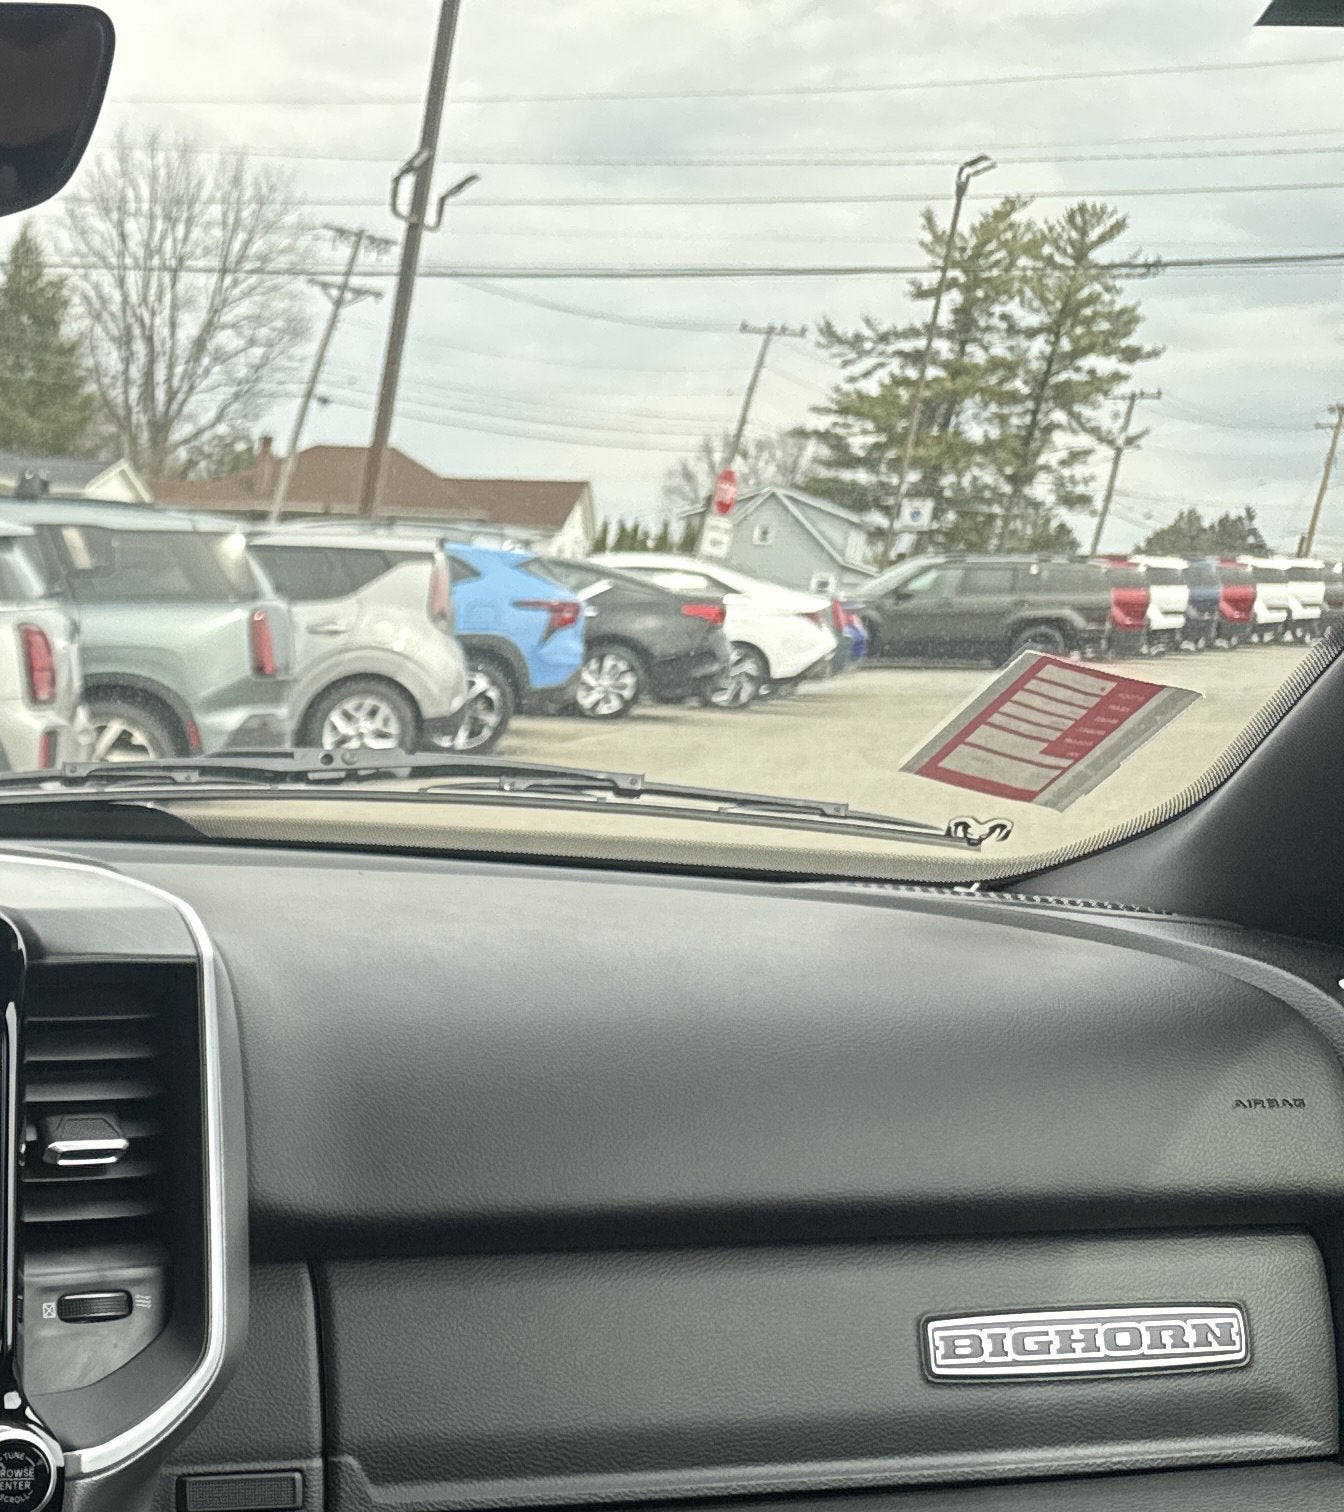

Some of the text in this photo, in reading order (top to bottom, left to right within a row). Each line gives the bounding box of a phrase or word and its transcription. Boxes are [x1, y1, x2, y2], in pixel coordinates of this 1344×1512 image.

[1233, 1098, 1306, 1109] AIRBAG
[934, 1319, 1239, 1364] BIGHORN
[3, 1451, 25, 1461] TUNE
